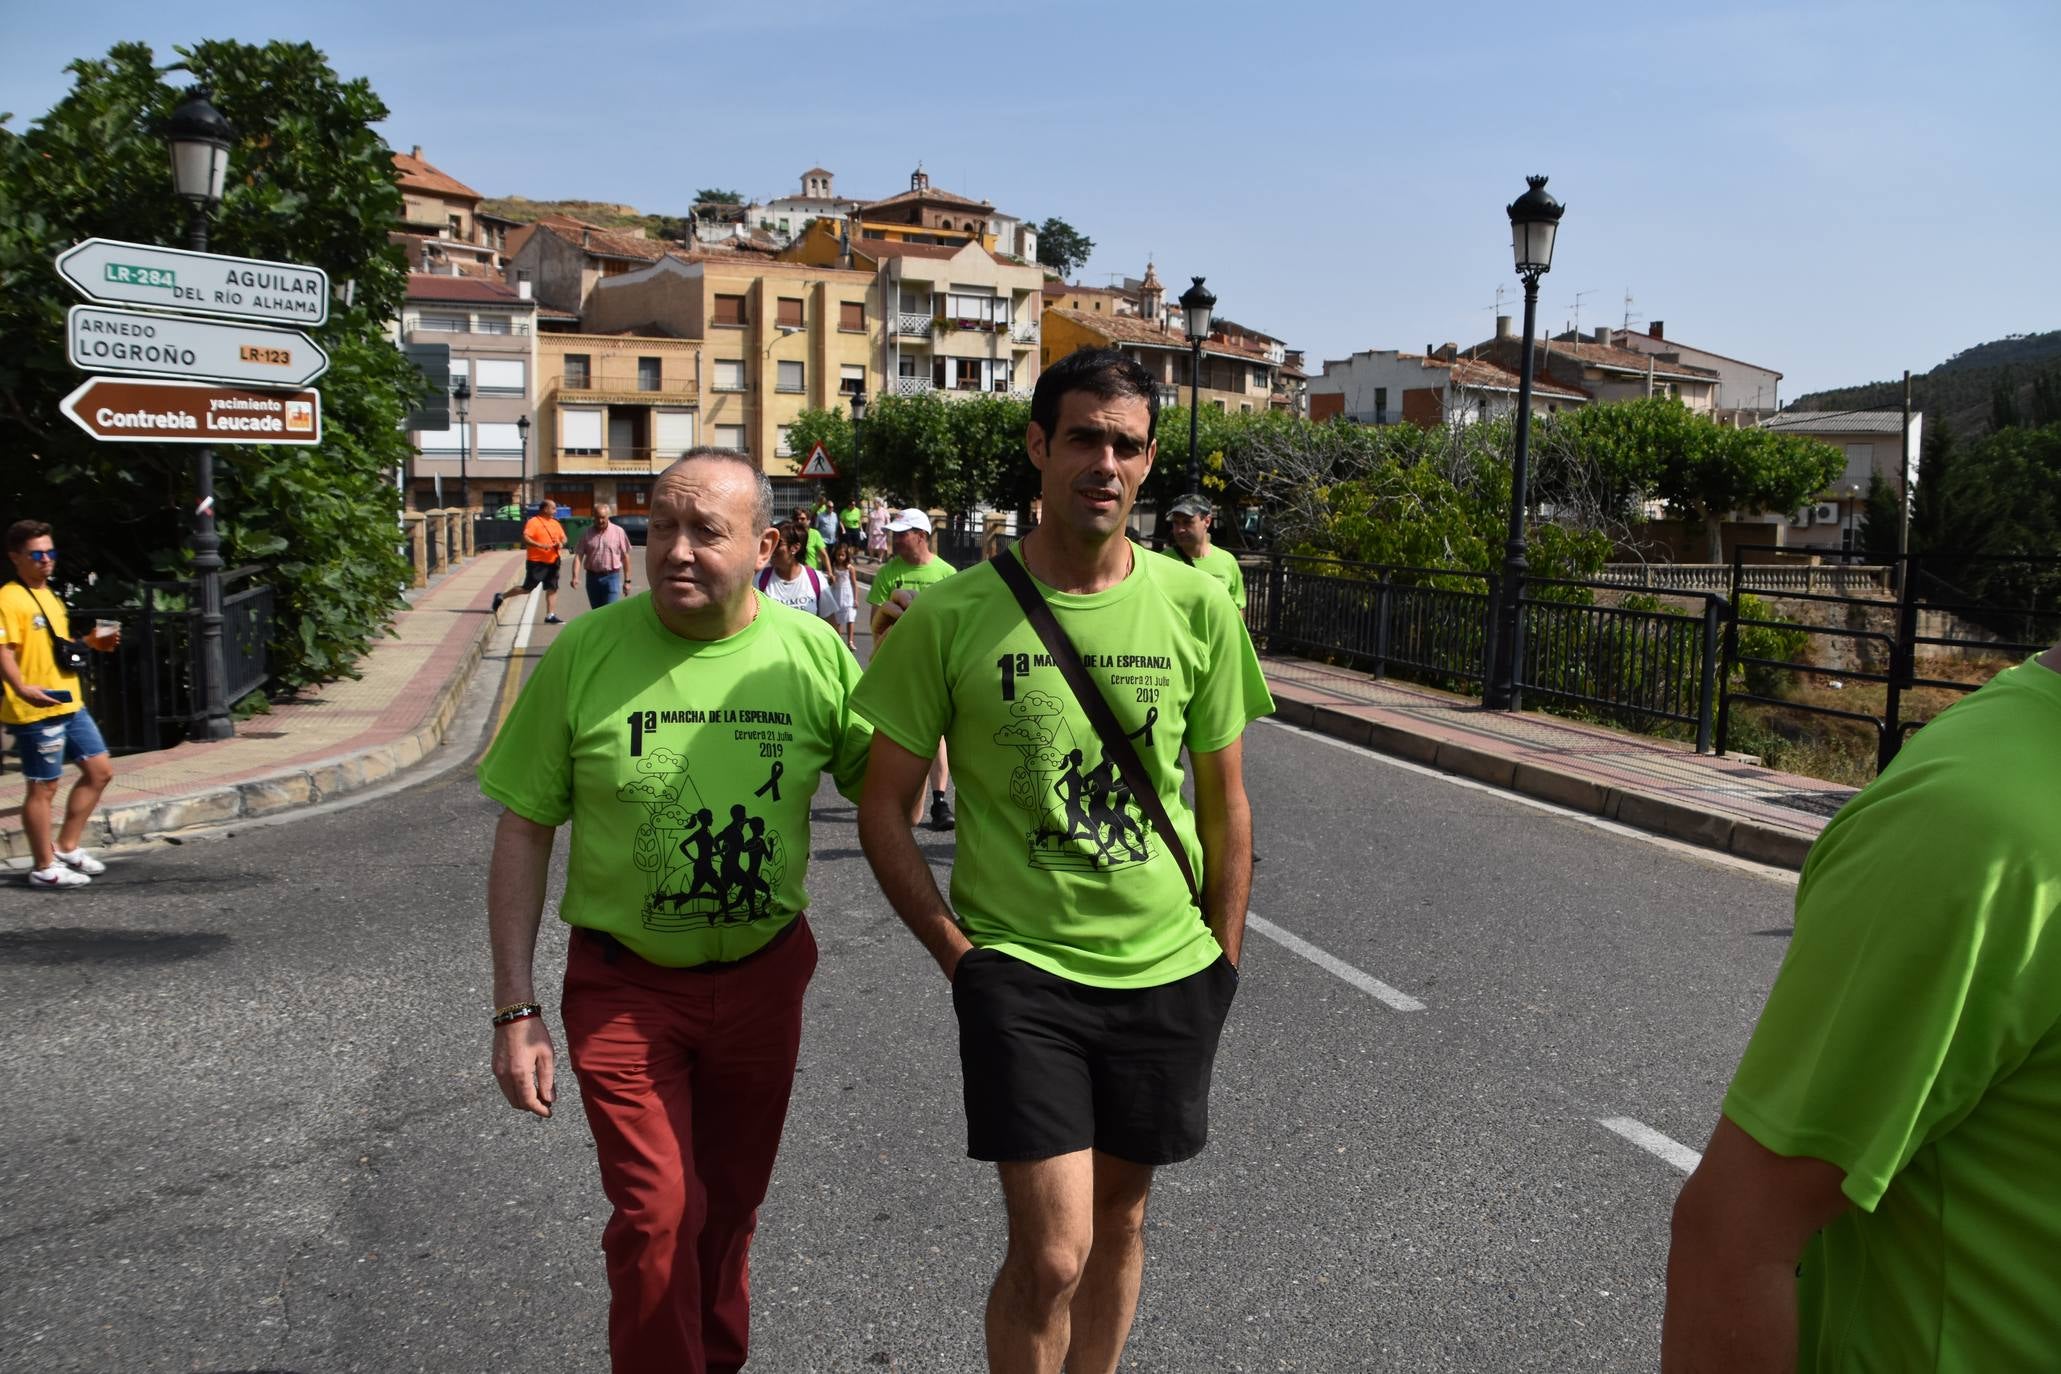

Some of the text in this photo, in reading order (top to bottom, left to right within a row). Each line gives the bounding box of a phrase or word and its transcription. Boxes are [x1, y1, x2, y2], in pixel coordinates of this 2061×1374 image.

[106, 264, 174, 287] LR-284
[225, 269, 317, 296] AGUILAR
[173, 285, 317, 314] DEL RÍO ALHAMA
[80, 318, 156, 338] ARNEDO
[80, 339, 196, 366] LOGROÑO
[239, 345, 290, 365] LR-123
[209, 396, 282, 412] yacimiento
[95, 408, 283, 432] Contrebia Leucade
[1100, 655, 1114, 668] LA
[1116, 655, 1172, 670] ESPERANZA
[1111, 674, 1143, 685] Cervera
[1144, 675, 1153, 686] 21
[1136, 688, 1160, 703] 2019
[660, 710, 705, 723] MARCHA
[709, 710, 721, 723] DE
[724, 710, 737, 723] LA
[740, 710, 792, 726] ESPERANZA
[735, 729, 766, 741] Cervera
[767, 731, 775, 741] 21
[759, 743, 784, 758] 2019
